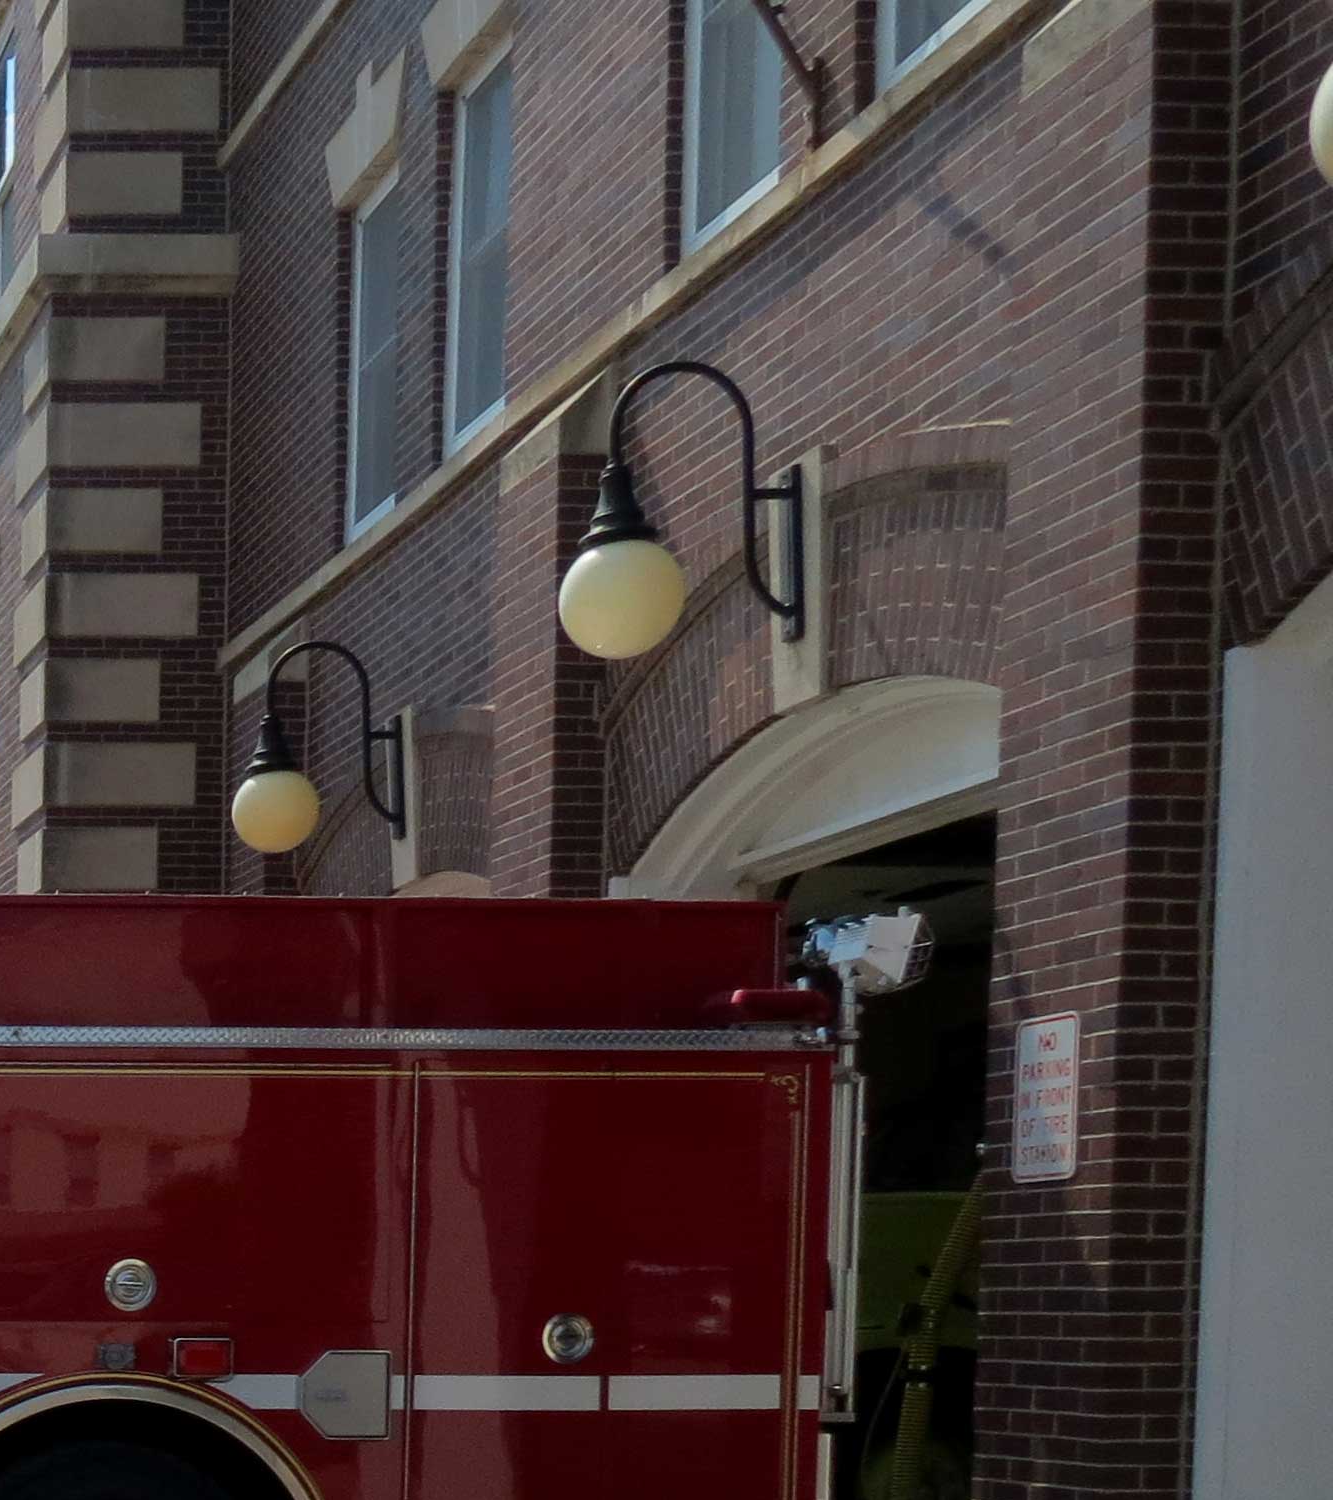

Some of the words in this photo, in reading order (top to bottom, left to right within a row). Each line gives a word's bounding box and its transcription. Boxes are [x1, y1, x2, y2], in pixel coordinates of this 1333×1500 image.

[1038, 1032, 1058, 1053] NO
[1022, 1058, 1071, 1082] PARKING
[1037, 1086, 1072, 1109] FRONT
[1021, 1118, 1038, 1138] OF
[1043, 1113, 1069, 1136] FIRE
[1020, 1142, 1069, 1166] STATION
